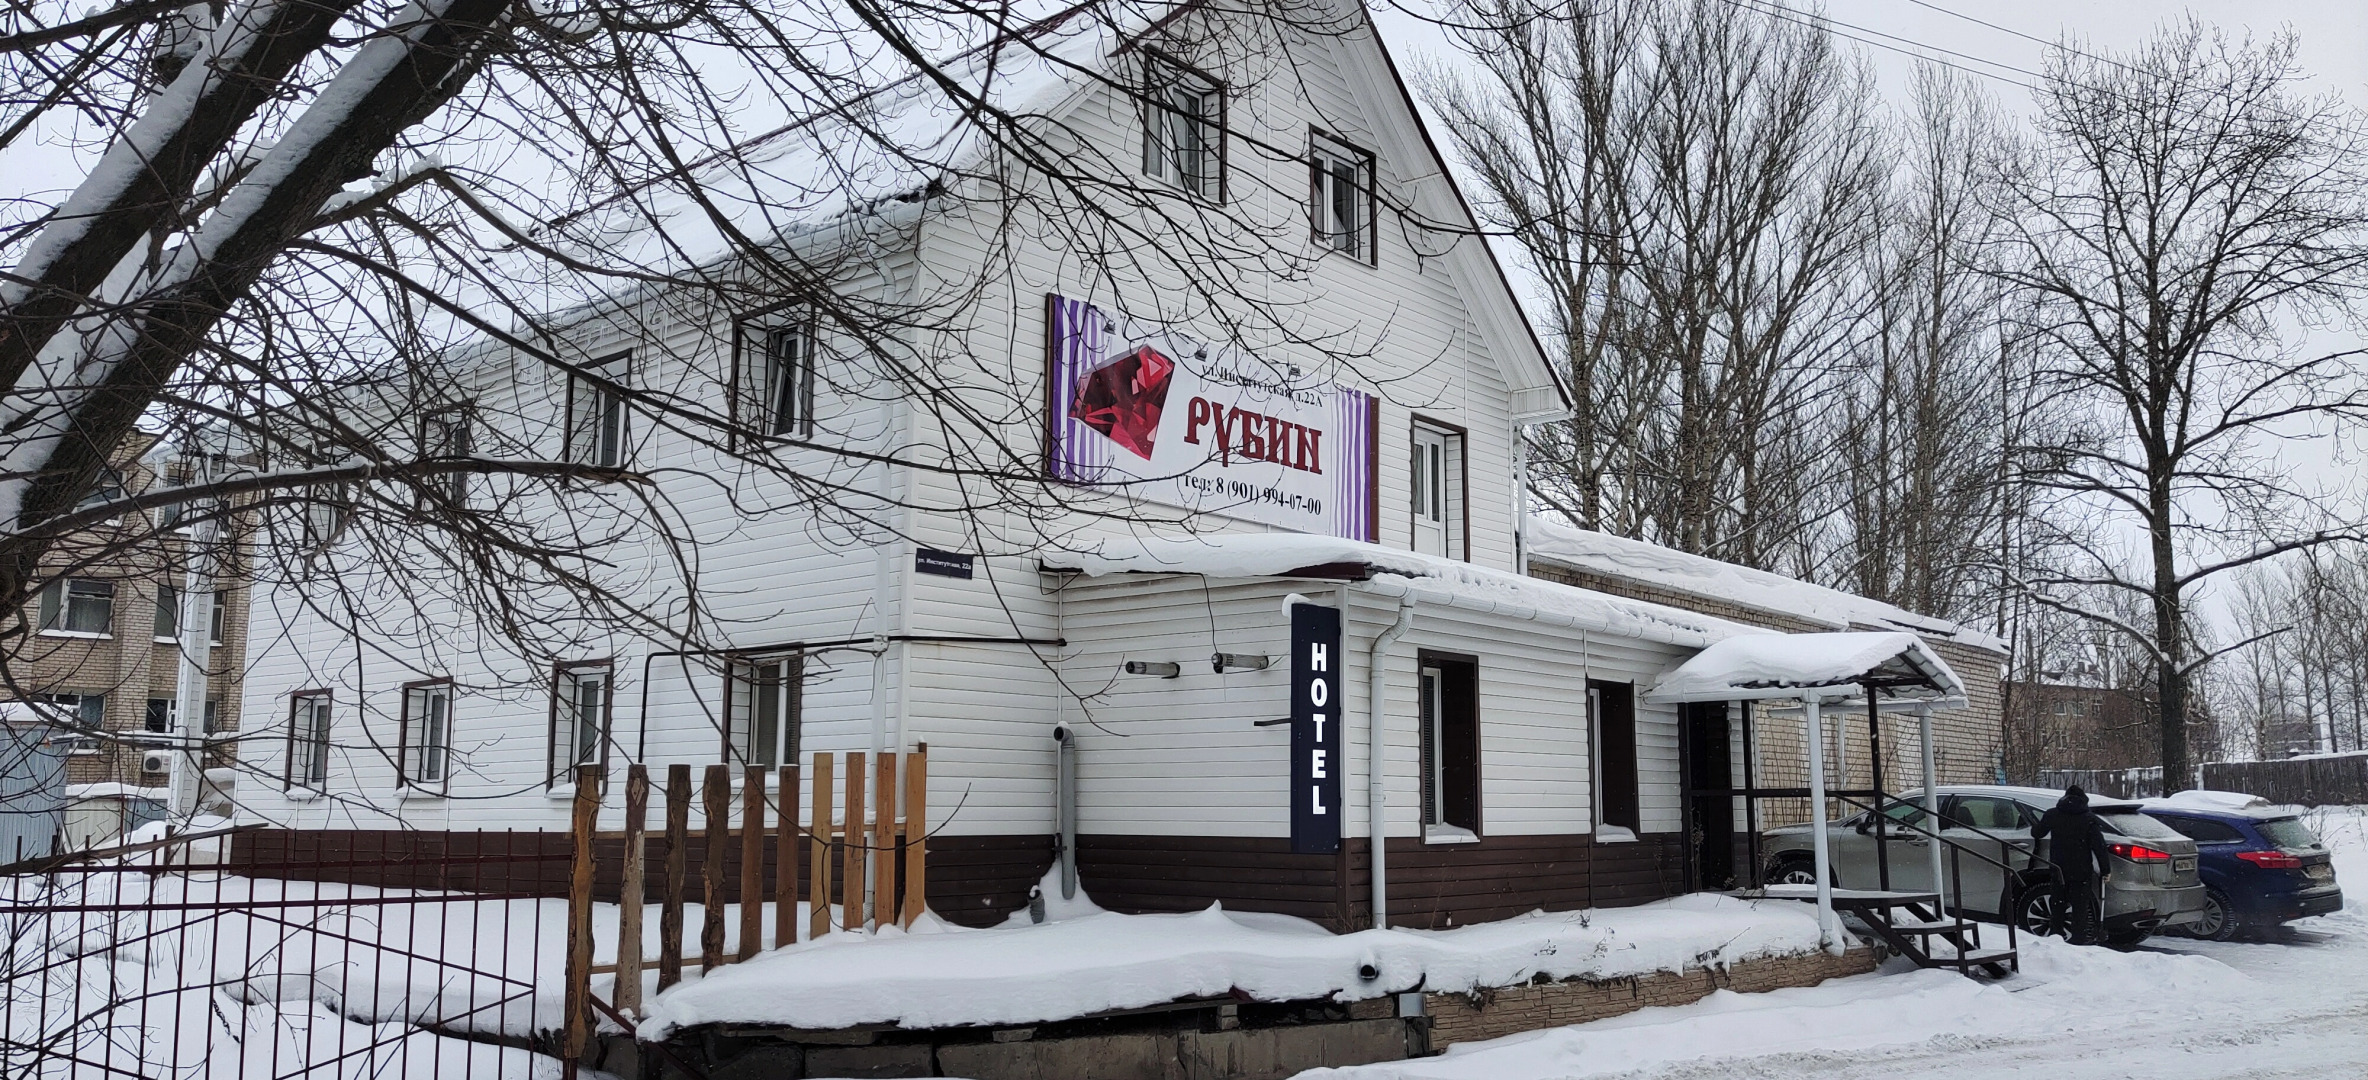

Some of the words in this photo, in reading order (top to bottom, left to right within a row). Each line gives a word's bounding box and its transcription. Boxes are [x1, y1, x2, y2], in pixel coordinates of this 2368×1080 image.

[1202, 364, 1218, 380] ул.
[1184, 396, 1323, 475] РУБИН
[1184, 474, 1211, 492] тел:
[1216, 476, 1224, 494] 8
[1227, 479, 1259, 505] (901)
[1263, 487, 1322, 516] 994-07-00
[1311, 642, 1328, 815] HOTEL
